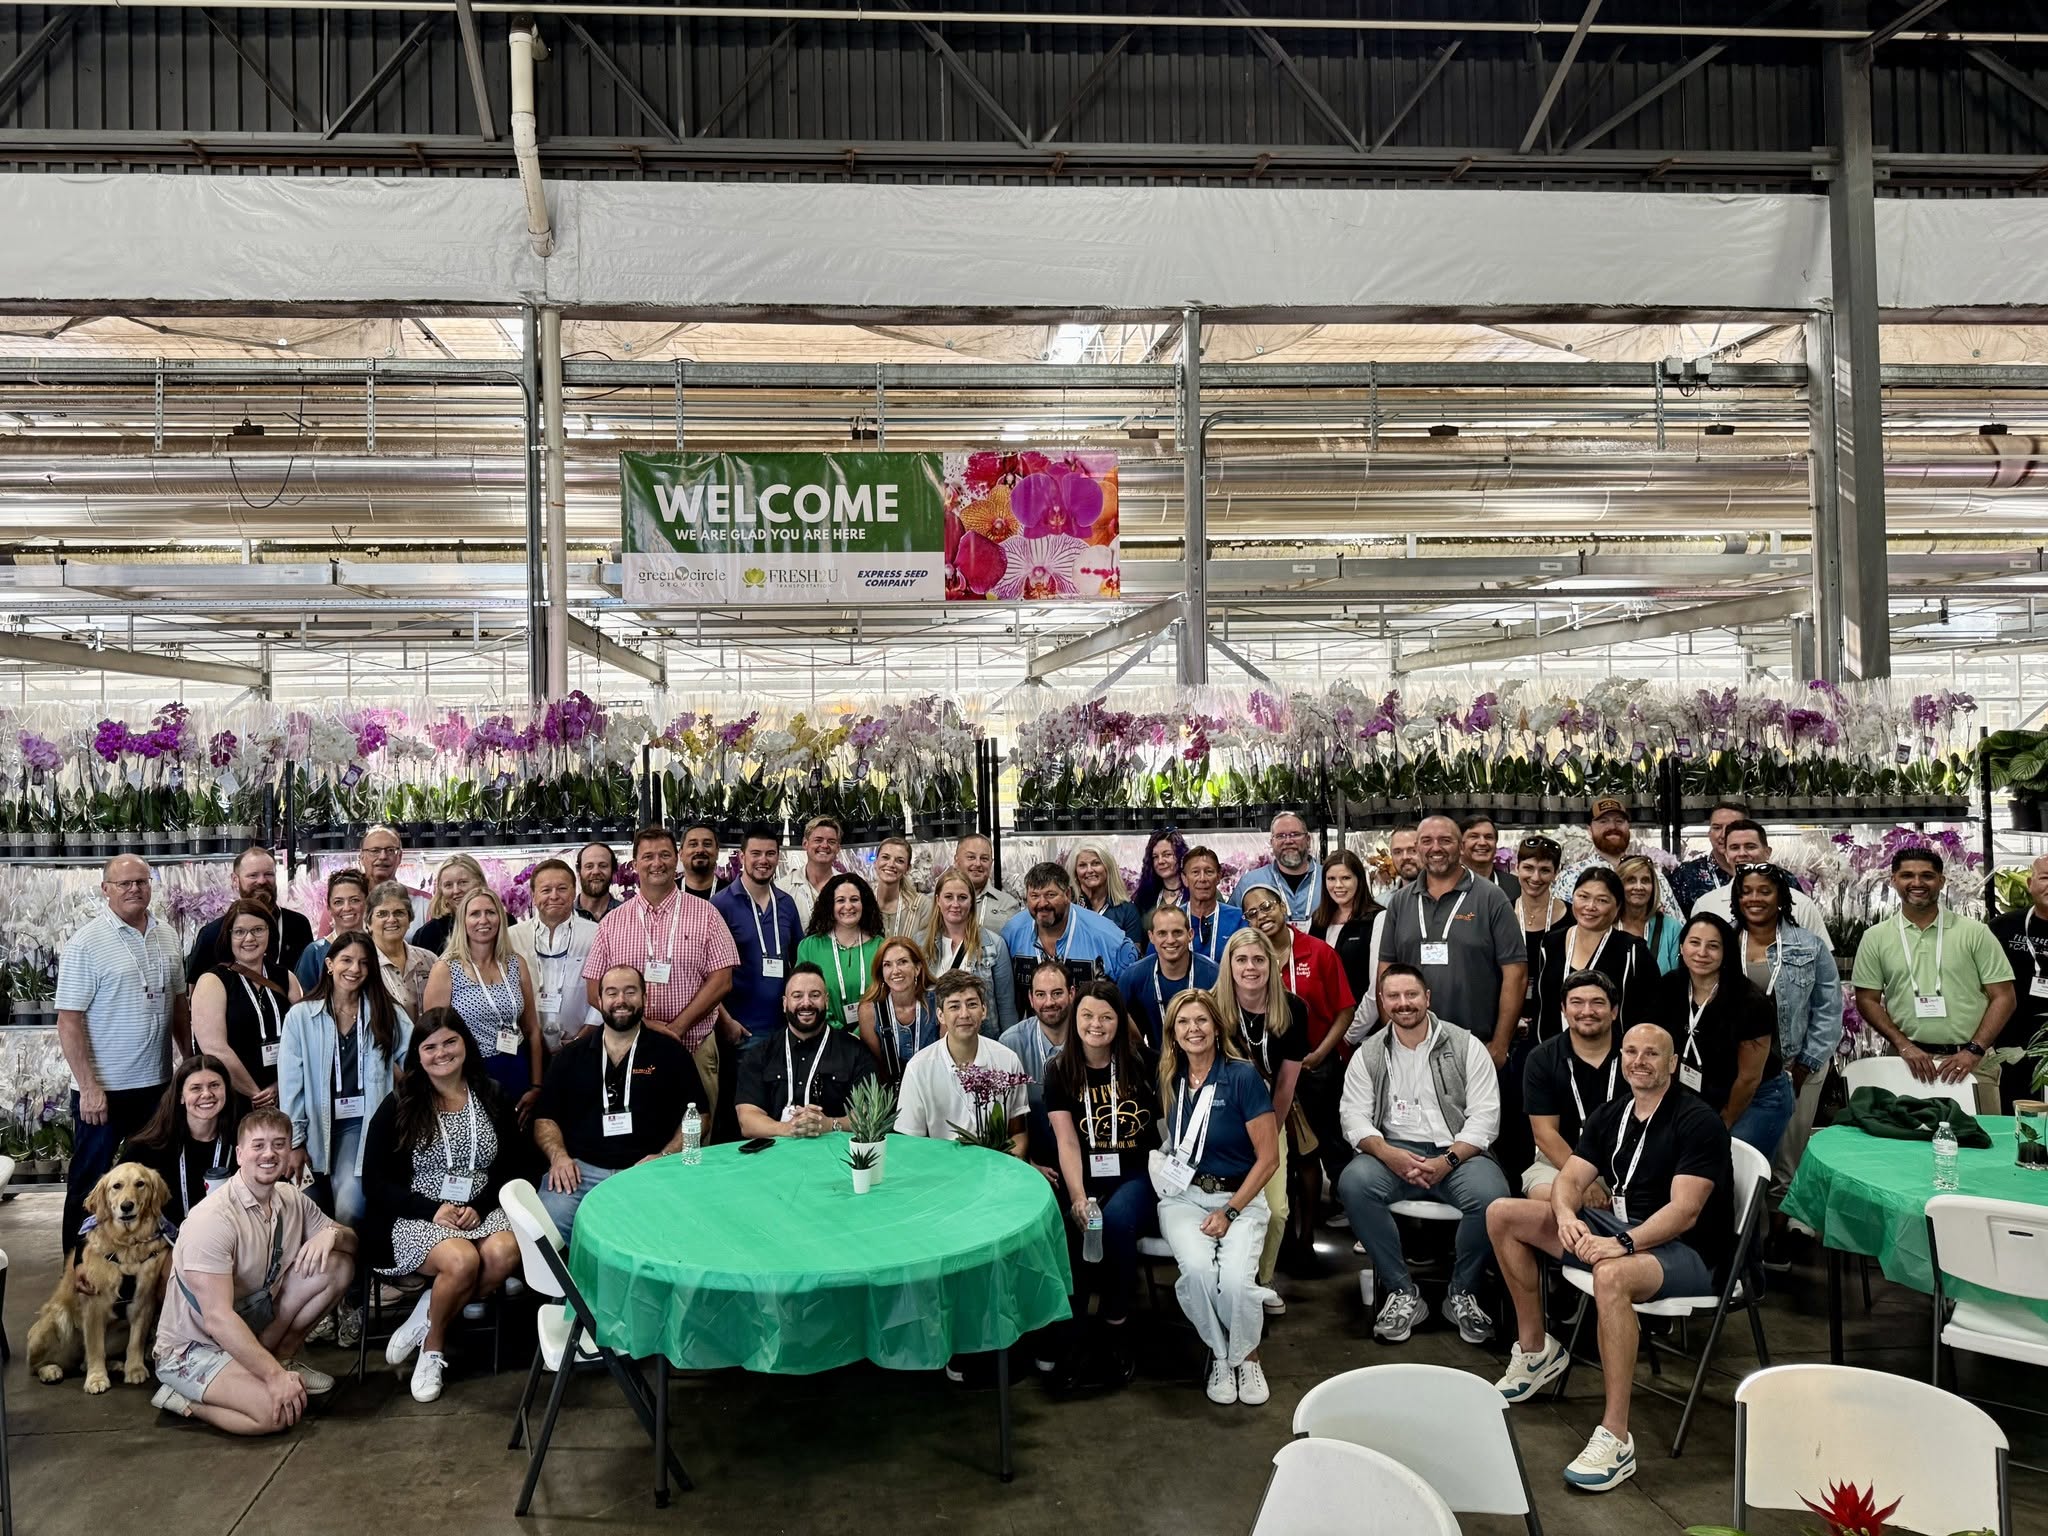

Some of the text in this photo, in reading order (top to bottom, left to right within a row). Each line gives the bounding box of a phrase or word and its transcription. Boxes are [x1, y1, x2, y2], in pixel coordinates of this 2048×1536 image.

[653, 484, 899, 523] WELCOME
[675, 528, 866, 541] WE ARE GLAD YOU ARE HERE
[857, 570, 929, 579] EXPRESS SEED
[864, 579, 917, 587] COMPANY
